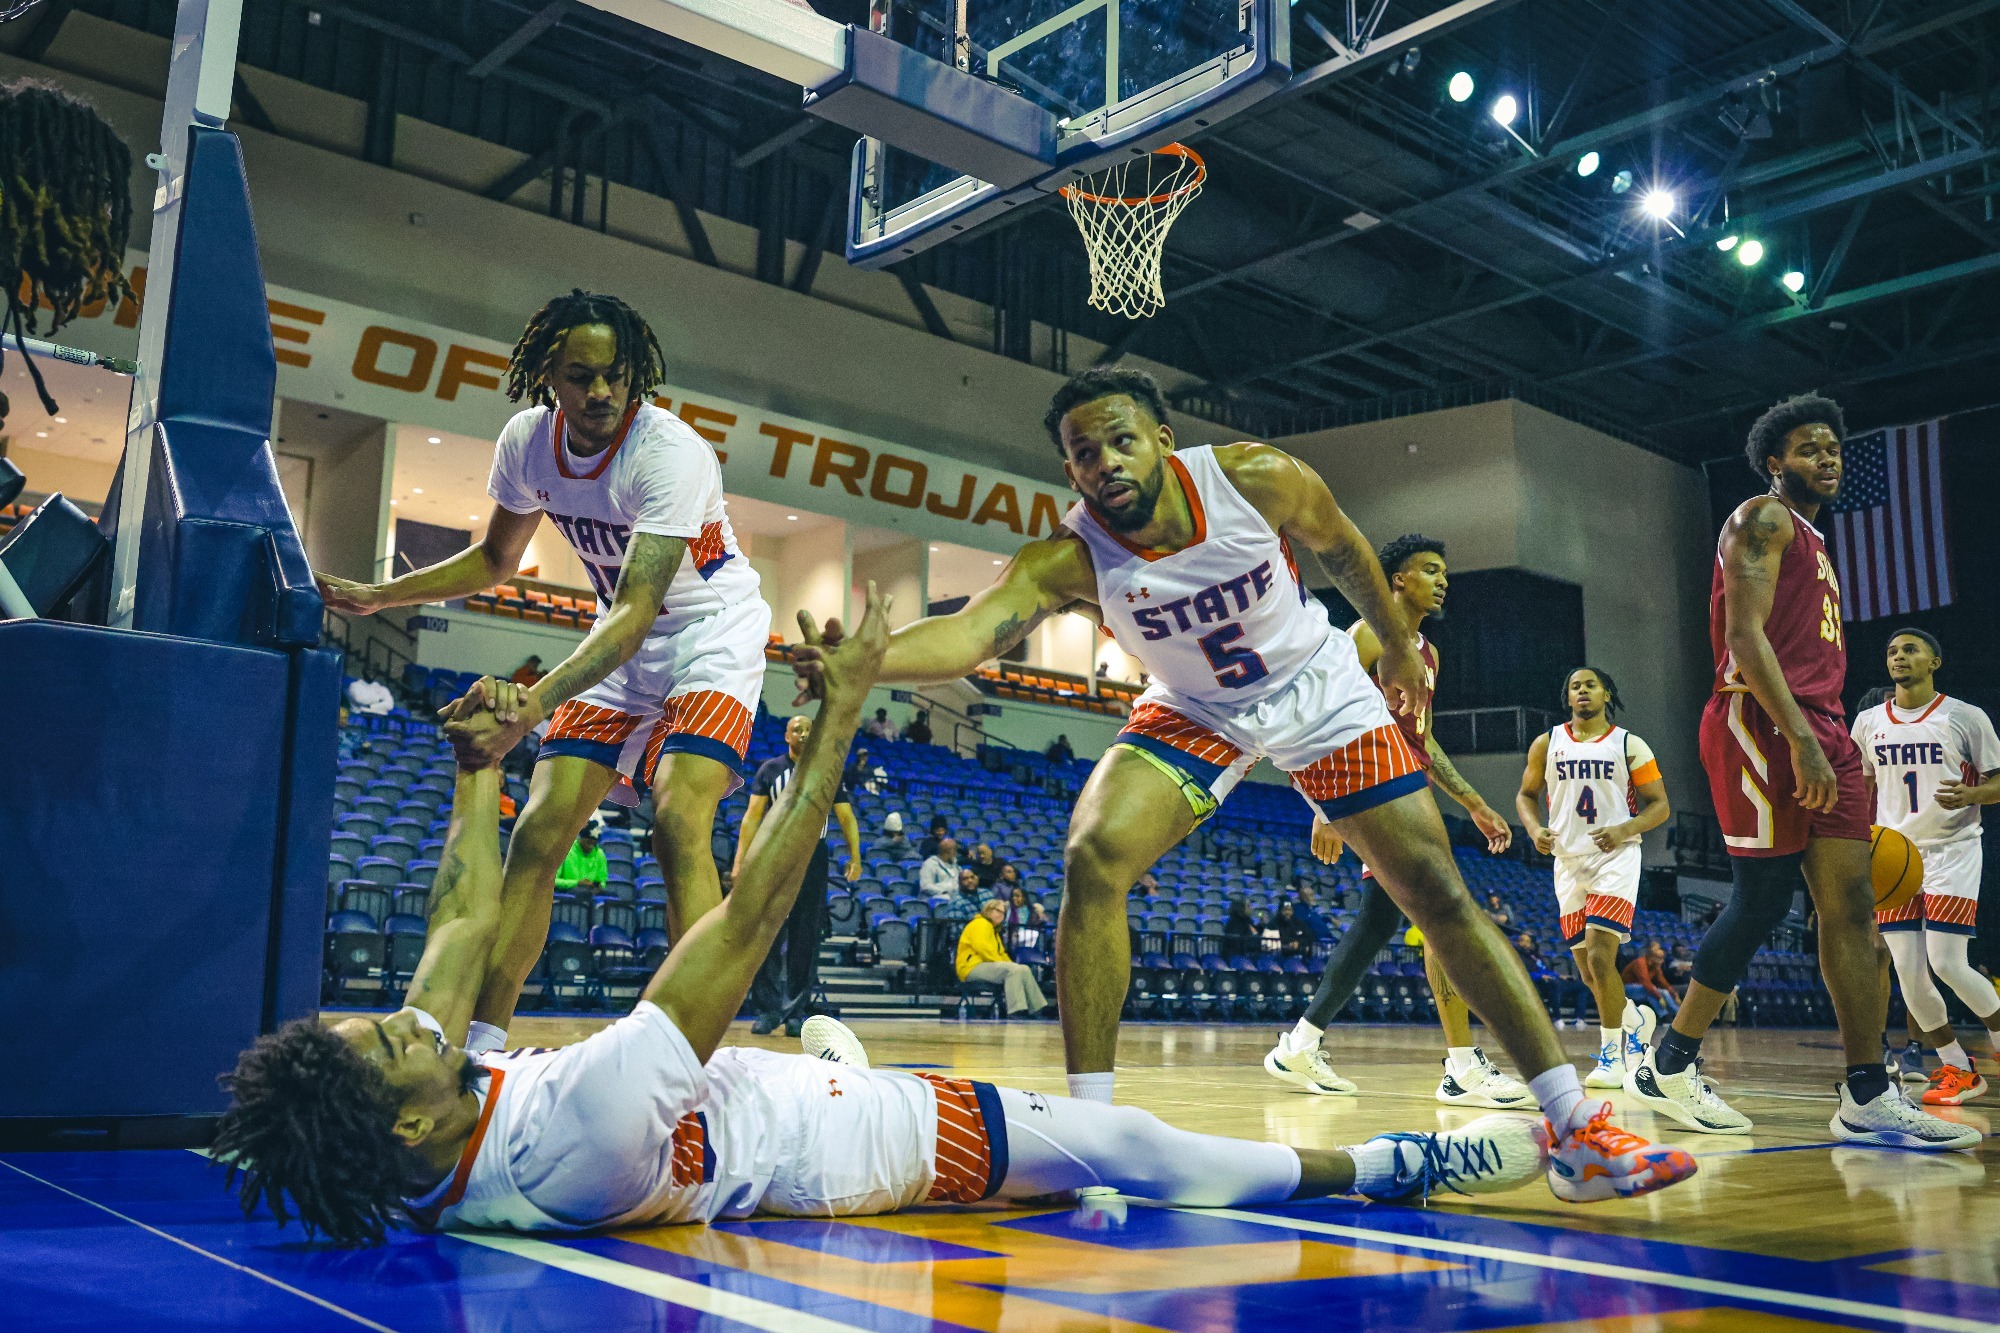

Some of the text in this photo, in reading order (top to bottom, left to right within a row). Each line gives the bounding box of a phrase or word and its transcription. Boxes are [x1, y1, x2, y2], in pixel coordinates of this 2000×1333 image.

[351, 325, 511, 402] OF
[758, 421, 1081, 538] TROJAN
[544, 509, 631, 557] TATE
[1131, 560, 1274, 641] STATE
[1196, 621, 1270, 690] 5
[1555, 759, 1615, 781] STATE
[1874, 742, 1943, 767] STATE
[1575, 784, 1598, 825] 4
[1902, 770, 1919, 814] 1
